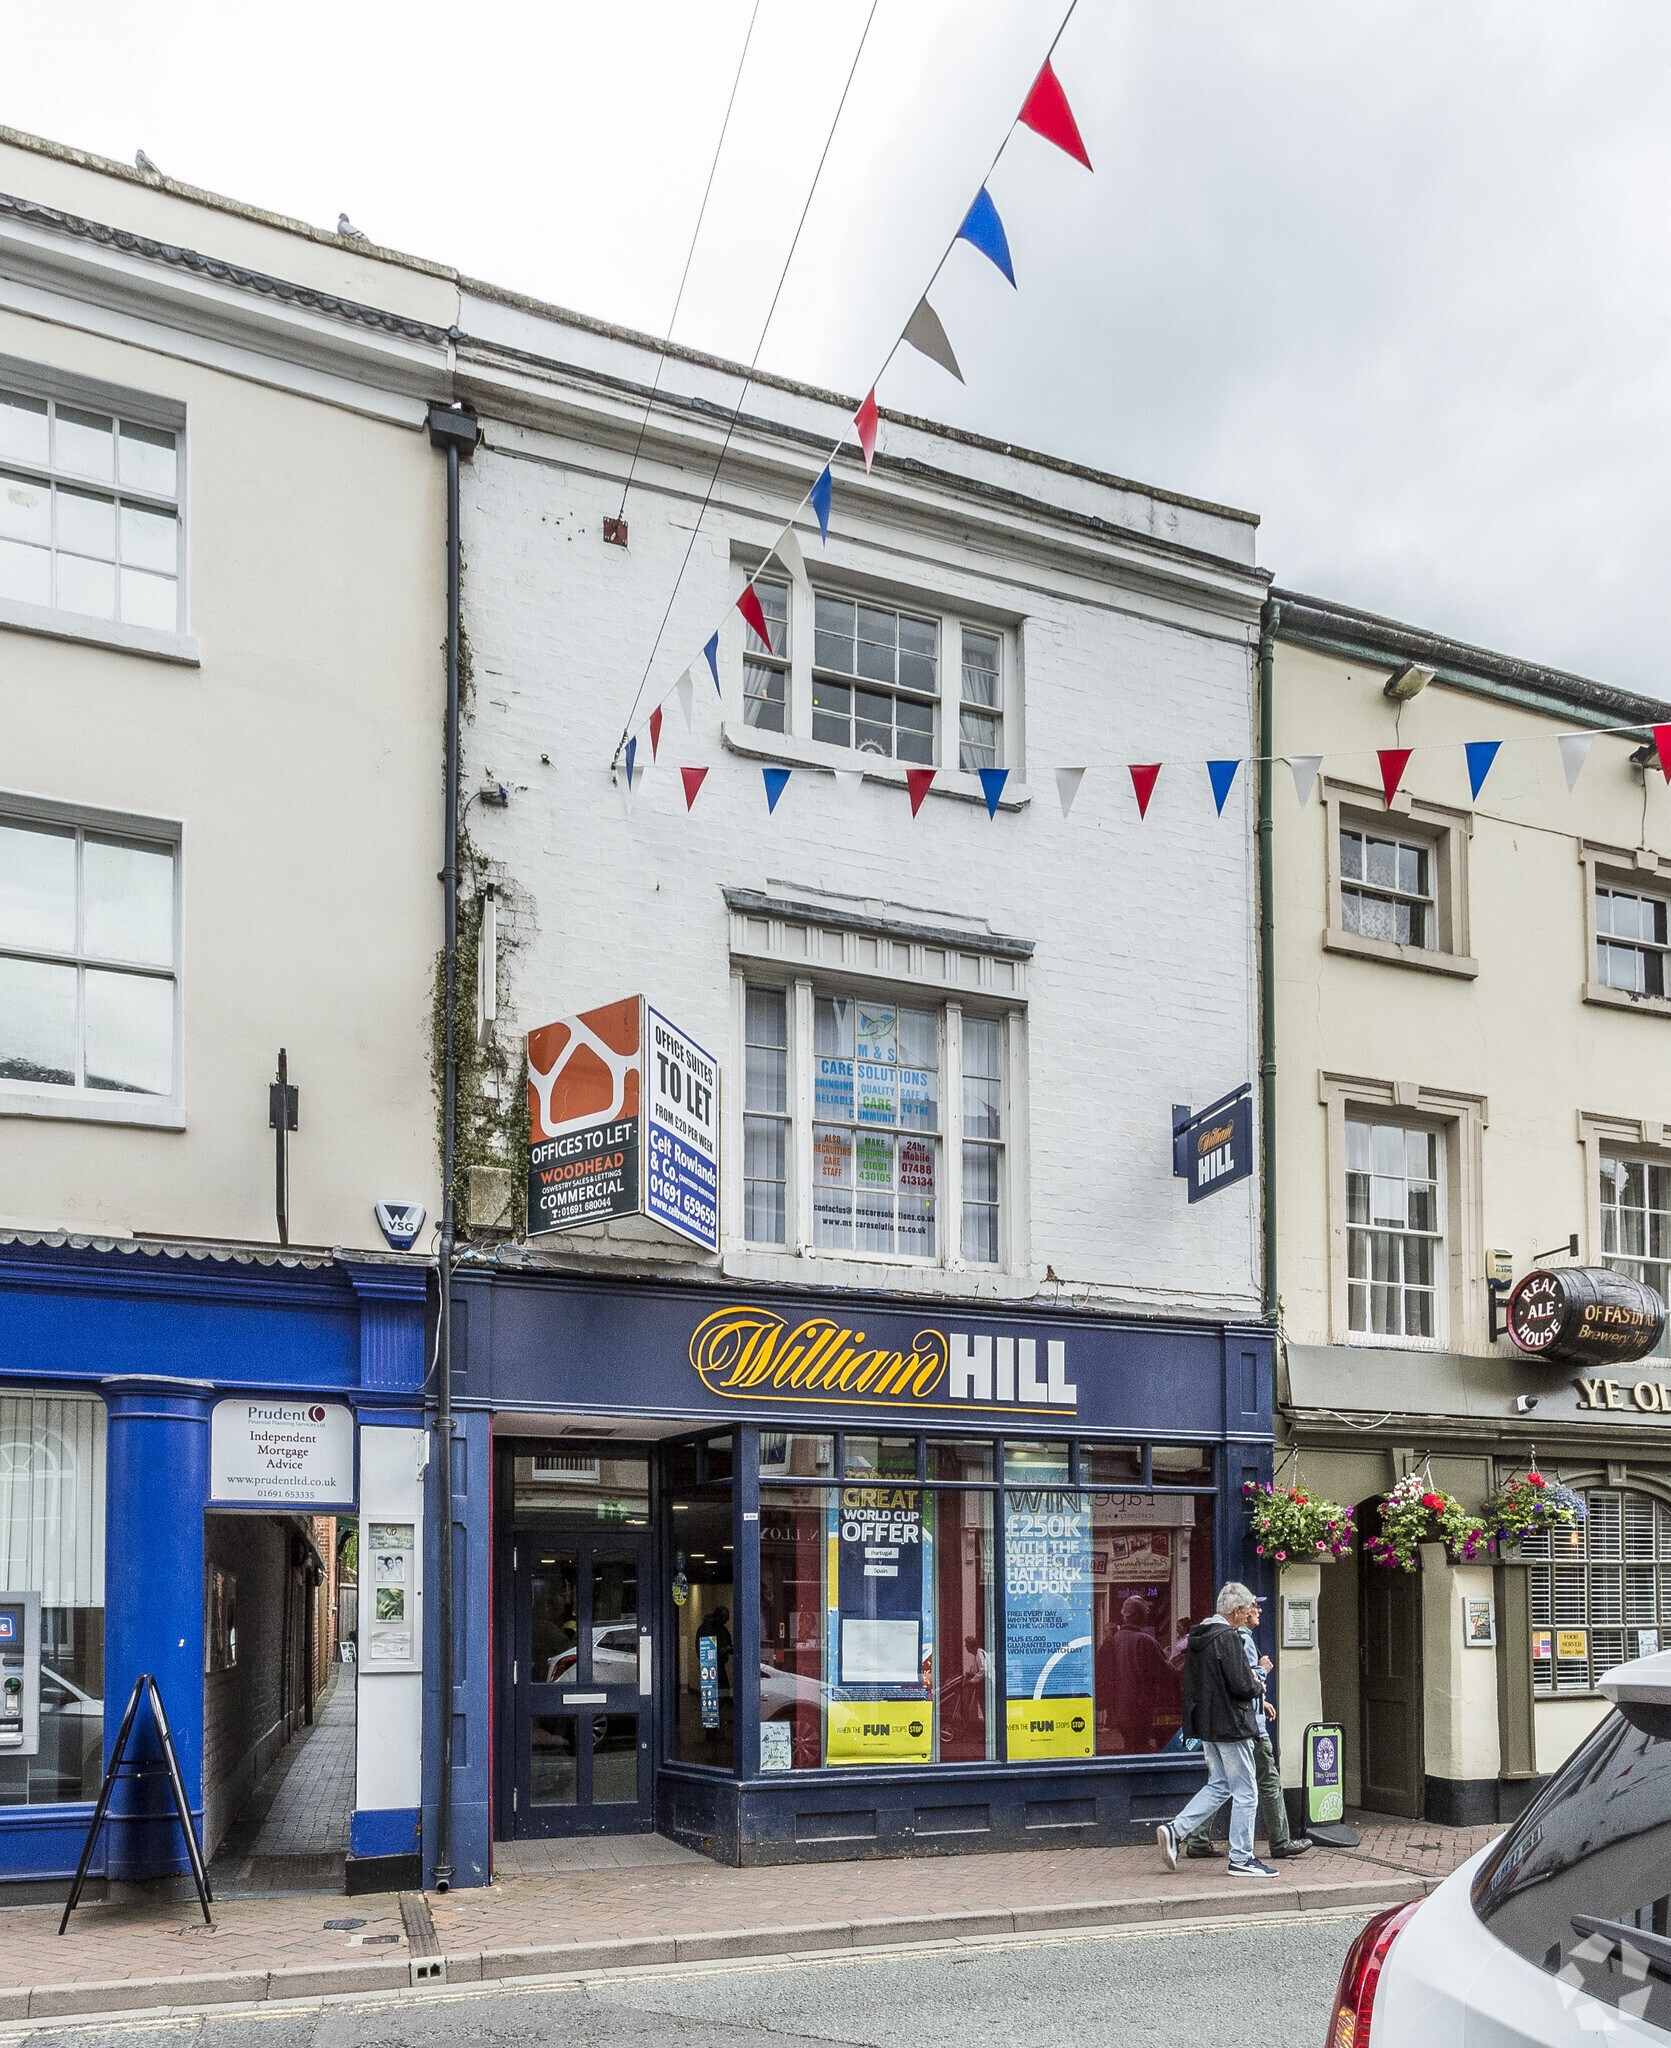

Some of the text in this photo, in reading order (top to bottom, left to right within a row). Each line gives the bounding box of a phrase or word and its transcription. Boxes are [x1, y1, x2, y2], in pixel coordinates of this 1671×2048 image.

[655, 1025, 712, 1086] OFFICE SUITES
[858, 1043, 895, 1062] M & S
[821, 1059, 928, 1086] CARE SOLUTIONS
[657, 1051, 711, 1127] TO LET
[861, 1083, 895, 1097] QUALITY
[900, 1088, 920, 1100] SAFE
[815, 1093, 929, 1116] RELIABLE CARE TO THE
[848, 1109, 905, 1125] COMMUNITY
[655, 1103, 714, 1155] FROM £20 PER WEEK
[532, 1123, 632, 1164] OFFICES TO LET
[824, 1134, 841, 1144] ALSO
[864, 1137, 886, 1148] MAKE
[906, 1141, 925, 1152] 24hr
[813, 1143, 852, 1157] RECRUITING
[902, 1151, 930, 1163] Mobile
[650, 1129, 716, 1188] Celt Rowlands
[823, 1156, 841, 1166] CARE
[862, 1160, 887, 1171] 01691
[1198, 1142, 1234, 1187] HILL
[541, 1152, 624, 1185] WOODHEAD
[650, 1151, 679, 1184] & Co.
[822, 1167, 842, 1177] STAFF
[901, 1163, 932, 1175] 07488
[542, 1169, 622, 1194] OSWESTRY SALES & LETTINGS
[859, 1171, 891, 1183] 430105
[900, 1175, 933, 1187] 413134
[540, 1178, 624, 1209] COMMERCIAL
[650, 1174, 716, 1227] 01691 659659
[584, 1197, 611, 1210] 680044
[388, 1220, 414, 1232] VSG
[650, 1195, 716, 1241] www.celtrowlands.co.uk
[1520, 1278, 1558, 1303] REAL
[1527, 1301, 1555, 1320] ALE
[1517, 1319, 1562, 1346] HOUSE
[1578, 1324, 1649, 1348] Brewery Tap
[689, 1306, 1077, 1405] William HILL
[1579, 1378, 1624, 1409] YE
[248, 1406, 306, 1421] Prudent
[250, 1431, 316, 1444] Independent
[257, 1445, 309, 1459] Mortgage
[266, 1459, 303, 1469] Advice
[227, 1475, 337, 1487] www.prudentltd.co.uk
[257, 1489, 315, 1499] 01691 653335
[843, 1487, 918, 1509] GREAT
[1008, 1491, 1081, 1513] WIN
[843, 1509, 920, 1522] WORLD CUP
[842, 1521, 919, 1544] OFFER
[1005, 1514, 1082, 1537] £250K
[1006, 1540, 1080, 1554] WITH THE
[1006, 1553, 1071, 1567] PERFECT
[1006, 1567, 1083, 1581] HAT TRICK
[1007, 1580, 1072, 1594] COUPON
[863, 1724, 890, 1736] FUN
[1030, 1720, 1055, 1733] FUN
